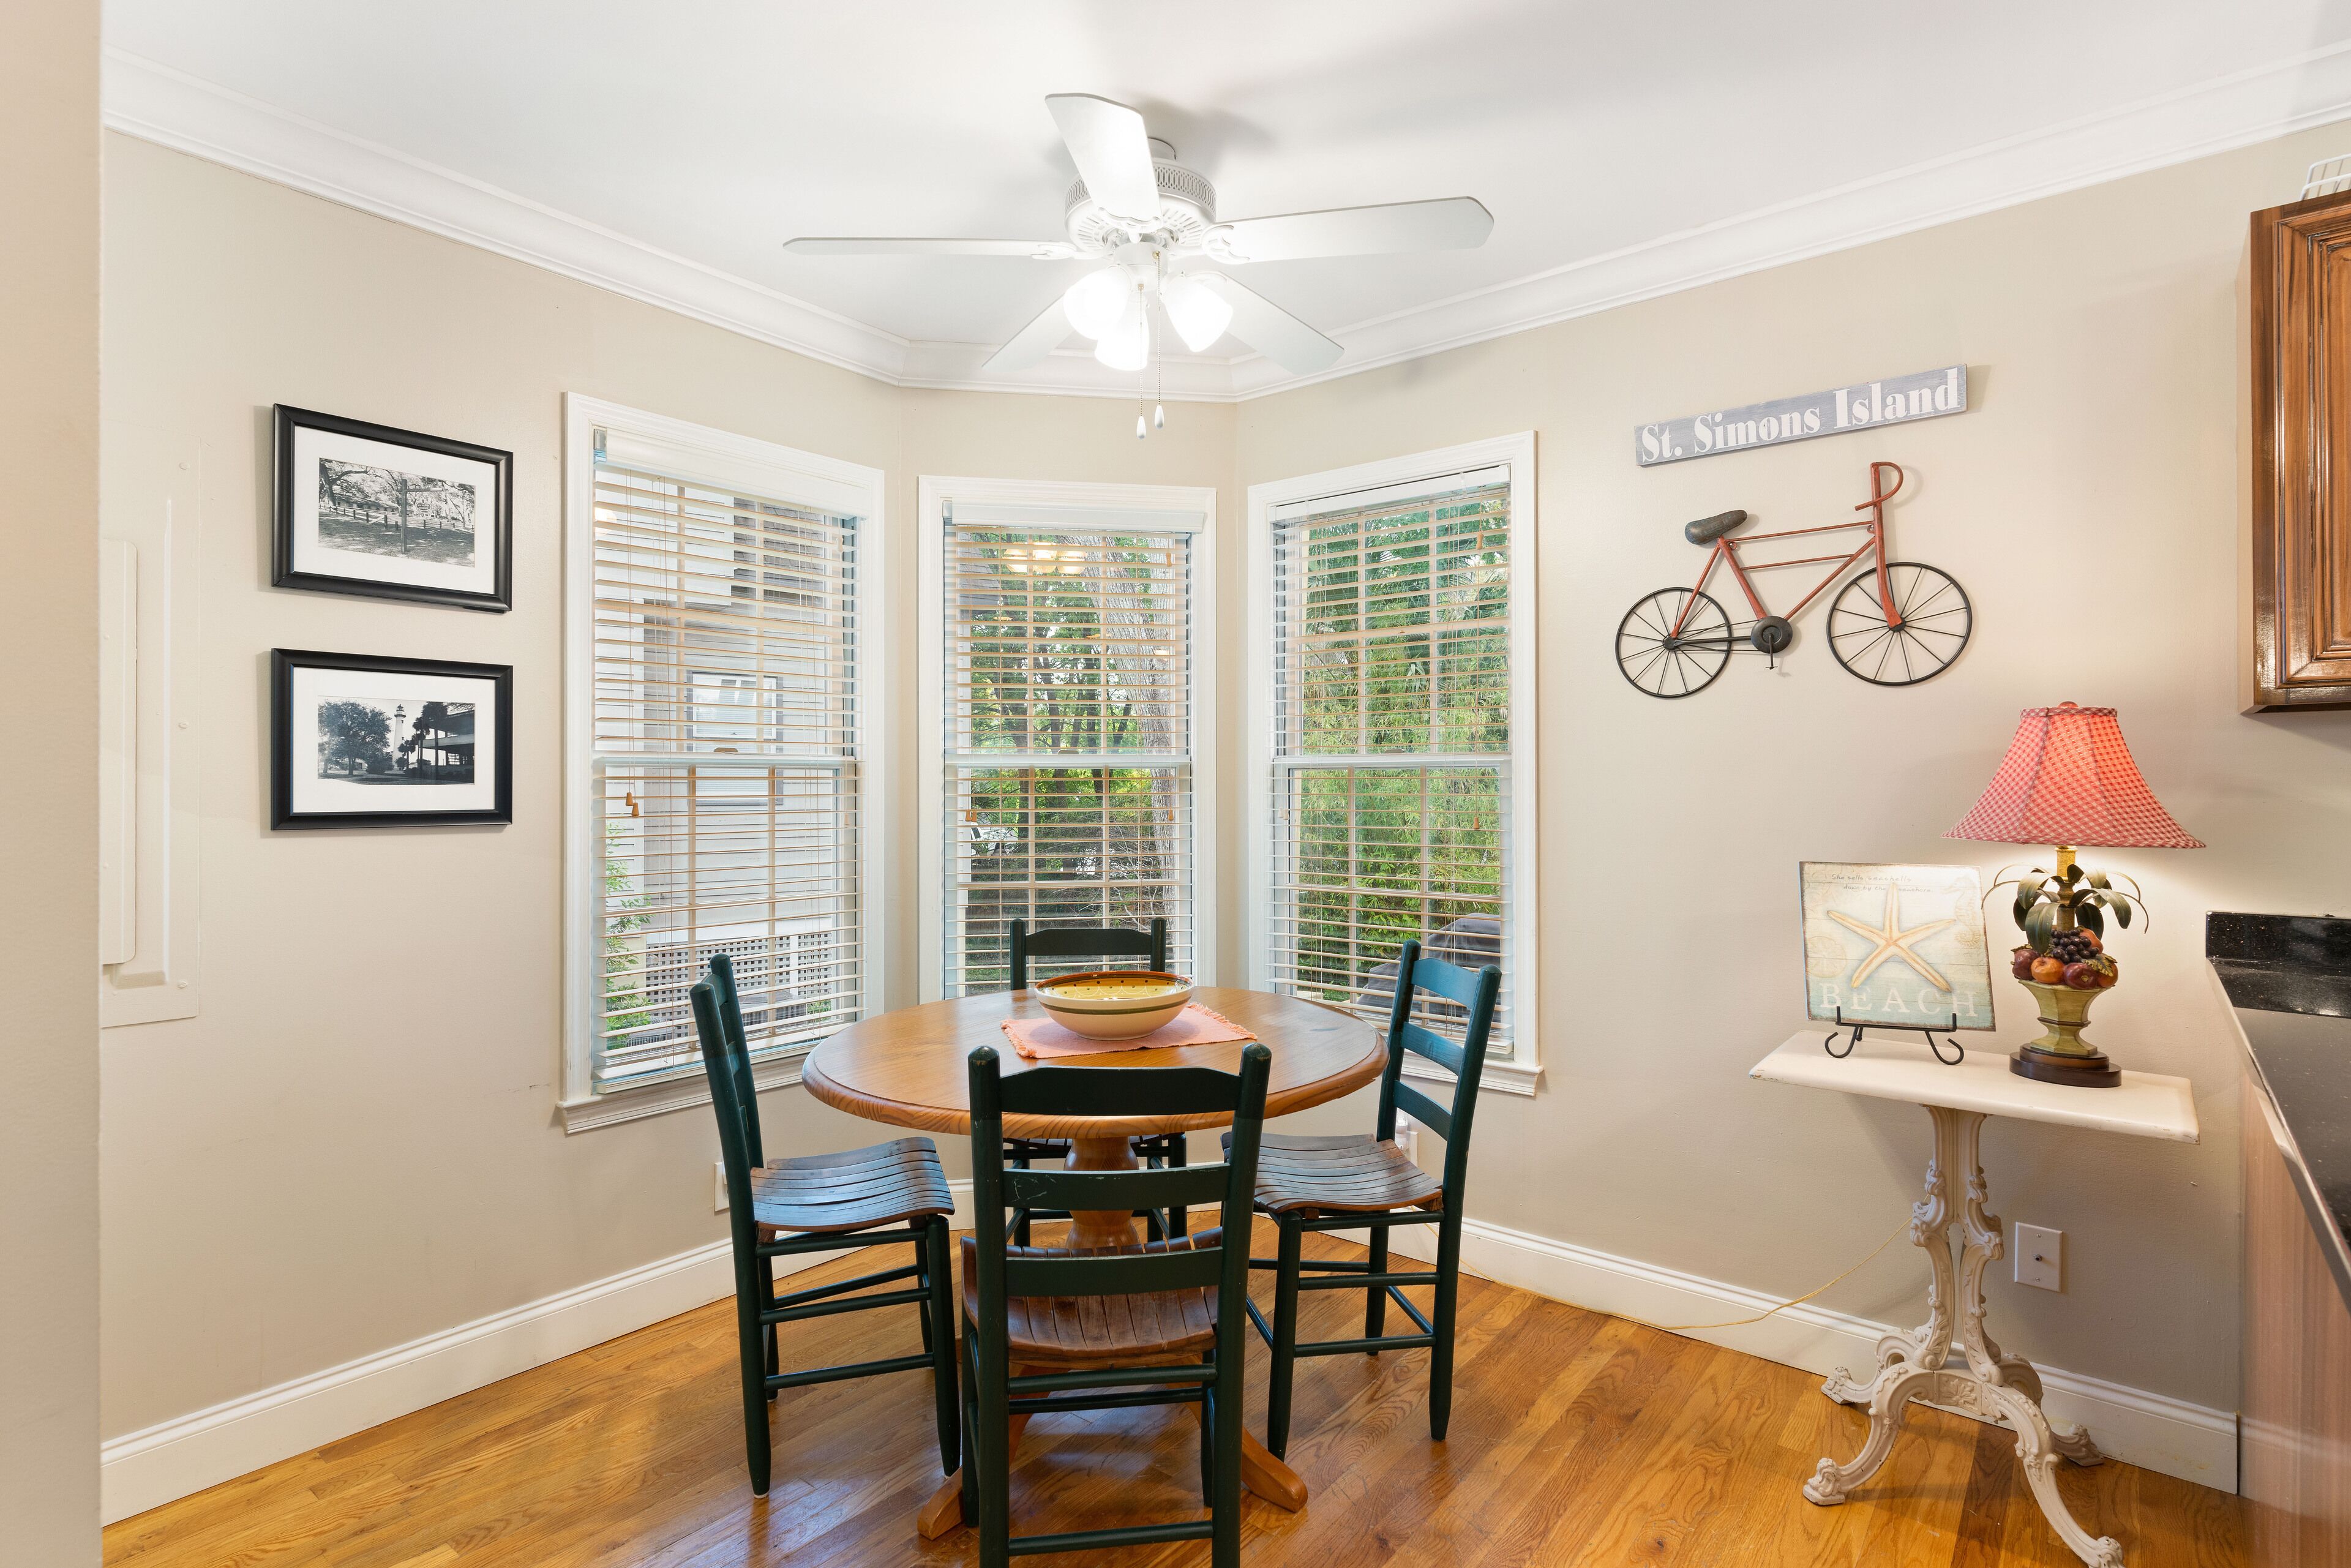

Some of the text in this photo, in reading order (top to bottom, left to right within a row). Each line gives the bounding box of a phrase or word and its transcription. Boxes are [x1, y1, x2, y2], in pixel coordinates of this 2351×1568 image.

[1641, 368, 1960, 463] St. Simons Island
[1820, 983, 1978, 1017] BEACH
